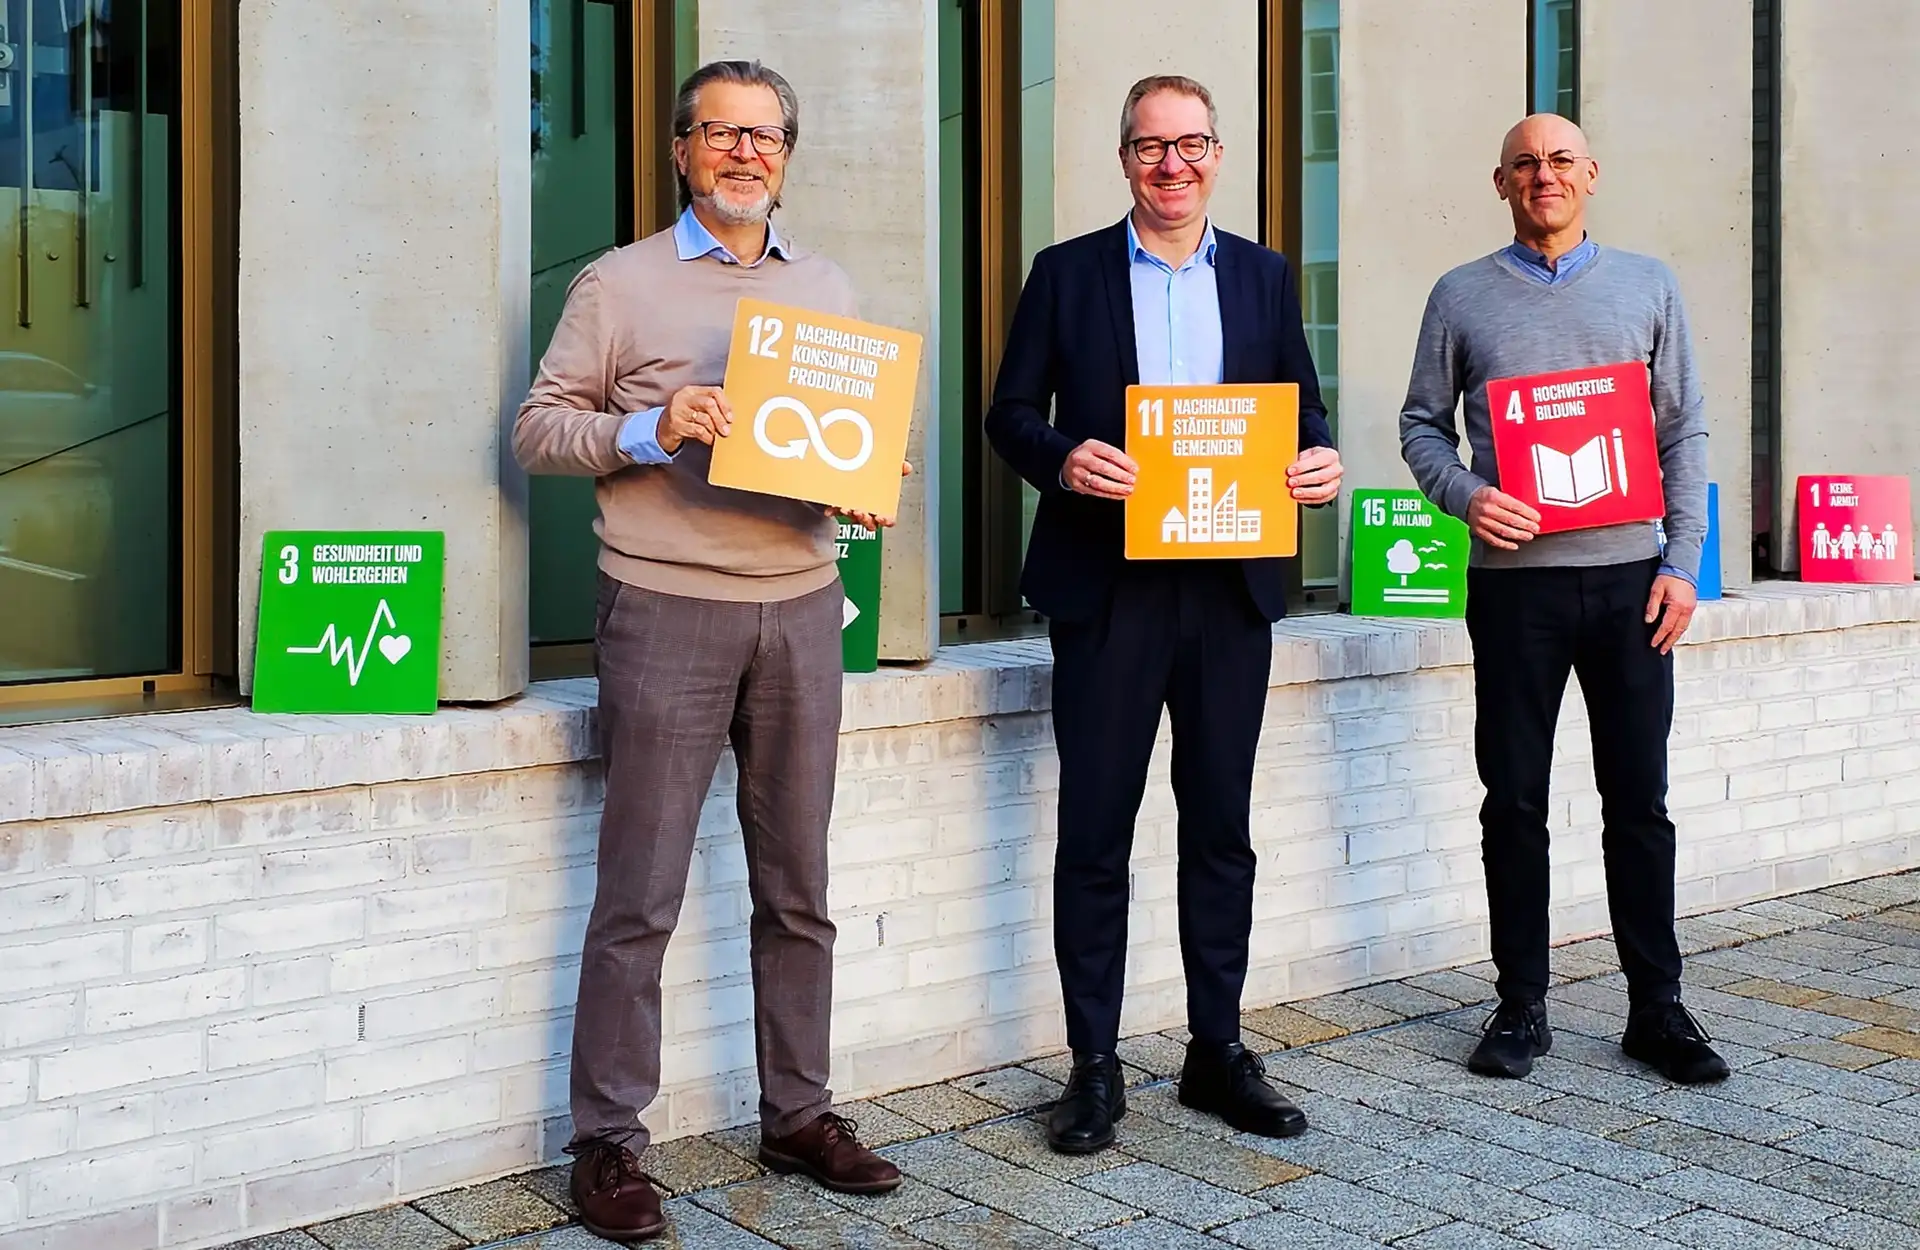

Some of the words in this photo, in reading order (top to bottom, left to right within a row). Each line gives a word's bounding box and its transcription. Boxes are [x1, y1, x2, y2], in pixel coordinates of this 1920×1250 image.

[748, 315, 784, 359] 12
[795, 322, 899, 362] NACHHALTIGE/R
[791, 344, 849, 374] KONSUM
[849, 358, 878, 379] UND
[787, 366, 875, 400] PRODUKTION
[1505, 389, 1526, 425] 4
[1531, 377, 1616, 403] HOCHWERTIGE
[1535, 400, 1586, 421] BILDUNG
[1138, 399, 1164, 436] 11
[1173, 397, 1257, 414] NACHHALTIGE
[1172, 417, 1219, 436] STÄDTE
[1221, 418, 1247, 436] UND
[1172, 439, 1243, 456] GEMEINDEN
[1810, 483, 1820, 507] 1
[1829, 483, 1854, 494] KEINE
[1830, 496, 1859, 507] ARMUT
[1362, 499, 1385, 526] 15
[1392, 499, 1421, 511] LEBEN
[1392, 514, 1406, 526] AN
[1406, 514, 1432, 526] LAND
[278, 545, 299, 584] 3
[313, 545, 393, 562] GESUNDHEIT
[395, 545, 422, 562] UND
[312, 566, 408, 584] WOHLERGEHEN
